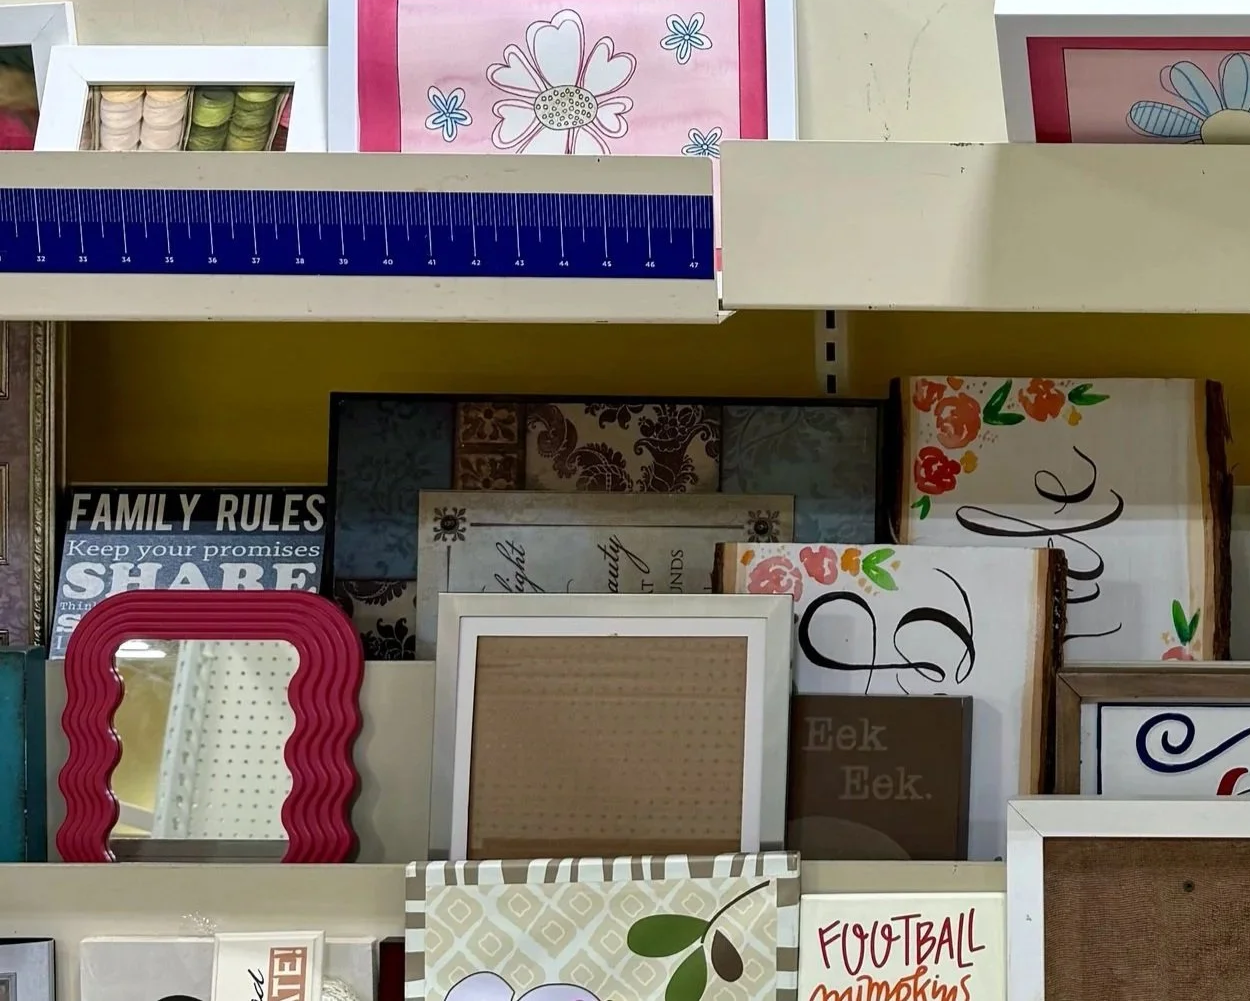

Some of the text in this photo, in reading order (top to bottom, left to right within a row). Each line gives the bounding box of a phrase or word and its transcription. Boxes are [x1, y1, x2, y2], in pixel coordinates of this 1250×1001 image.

[69, 493, 326, 532] FAMILY RULES
[66, 540, 321, 562] Keep your promises
[62, 562, 320, 599] SHARE
[60, 601, 97, 611] Thin
[802, 716, 888, 752] Eek
[837, 765, 933, 801] Eek.
[818, 907, 986, 976] FOOTBALL
